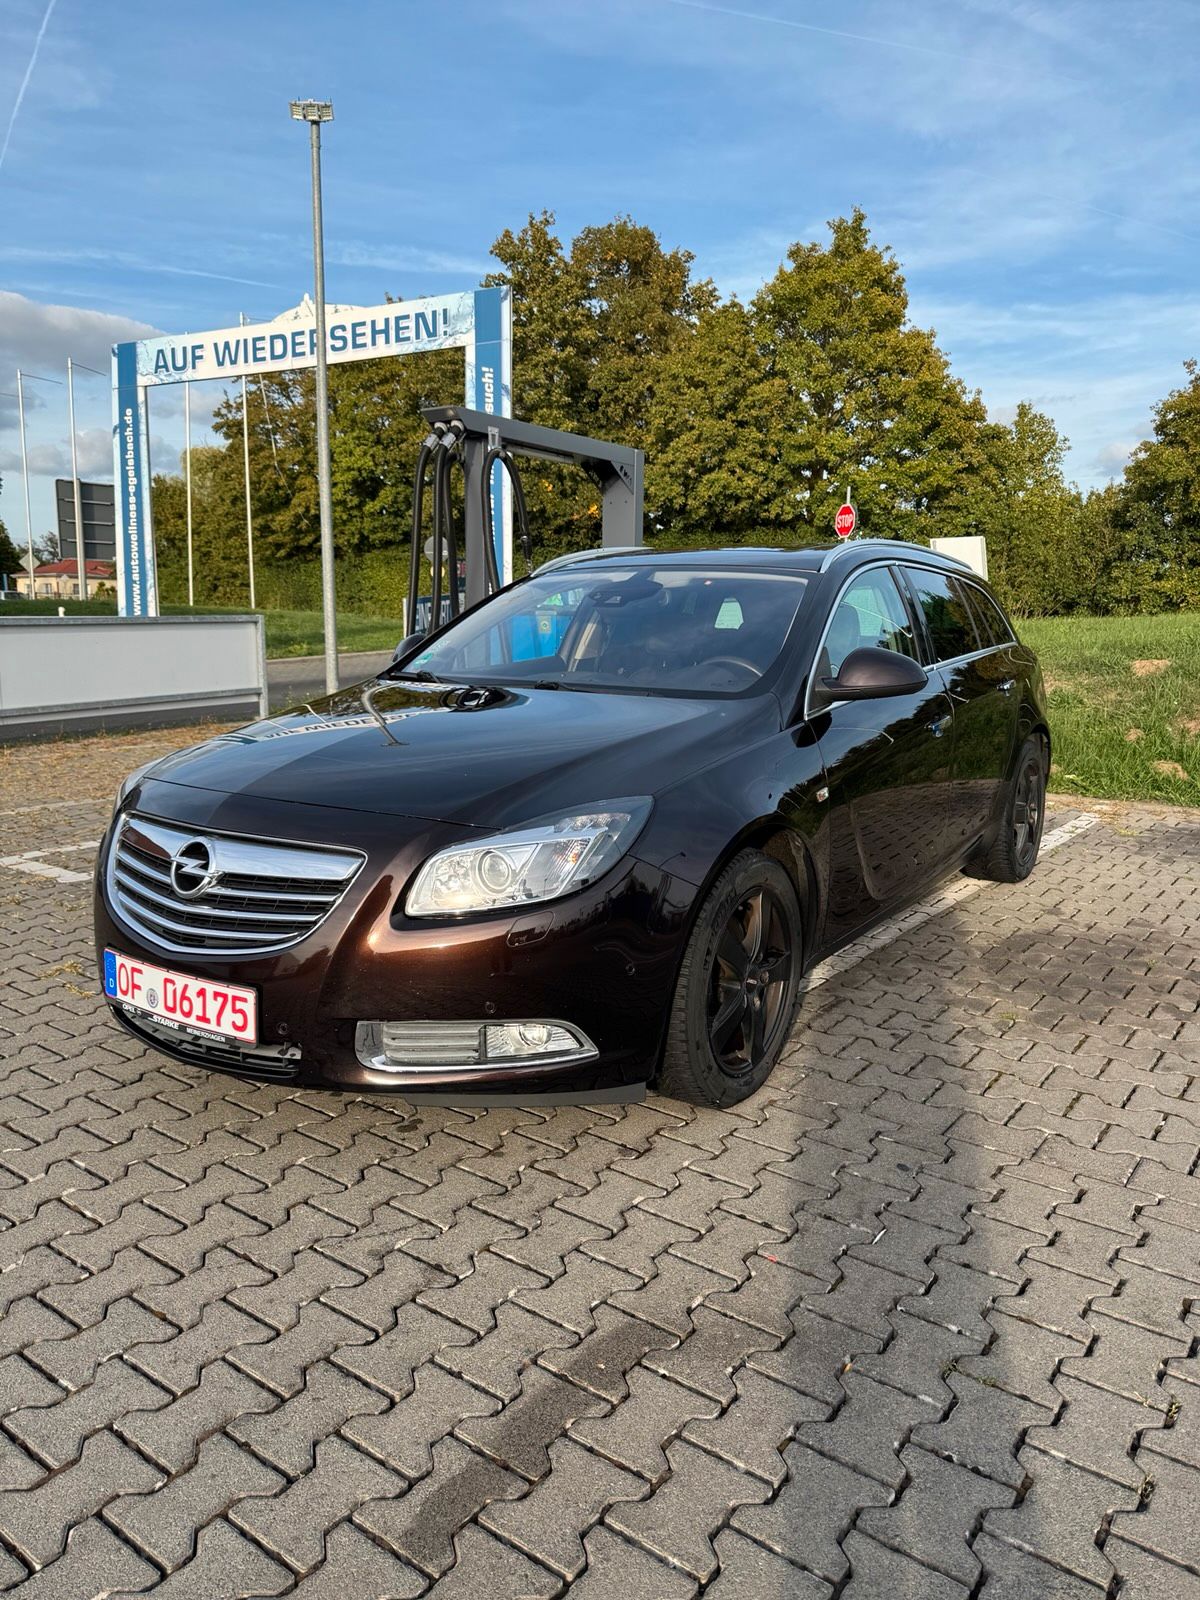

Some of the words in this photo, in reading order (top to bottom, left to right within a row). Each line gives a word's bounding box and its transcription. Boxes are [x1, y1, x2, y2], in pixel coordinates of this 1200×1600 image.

[153, 343, 204, 375] AUF
[837, 514, 853, 528] STOP
[109, 978, 114, 988] D
[118, 963, 143, 999] OF
[163, 977, 248, 1032] 06175
